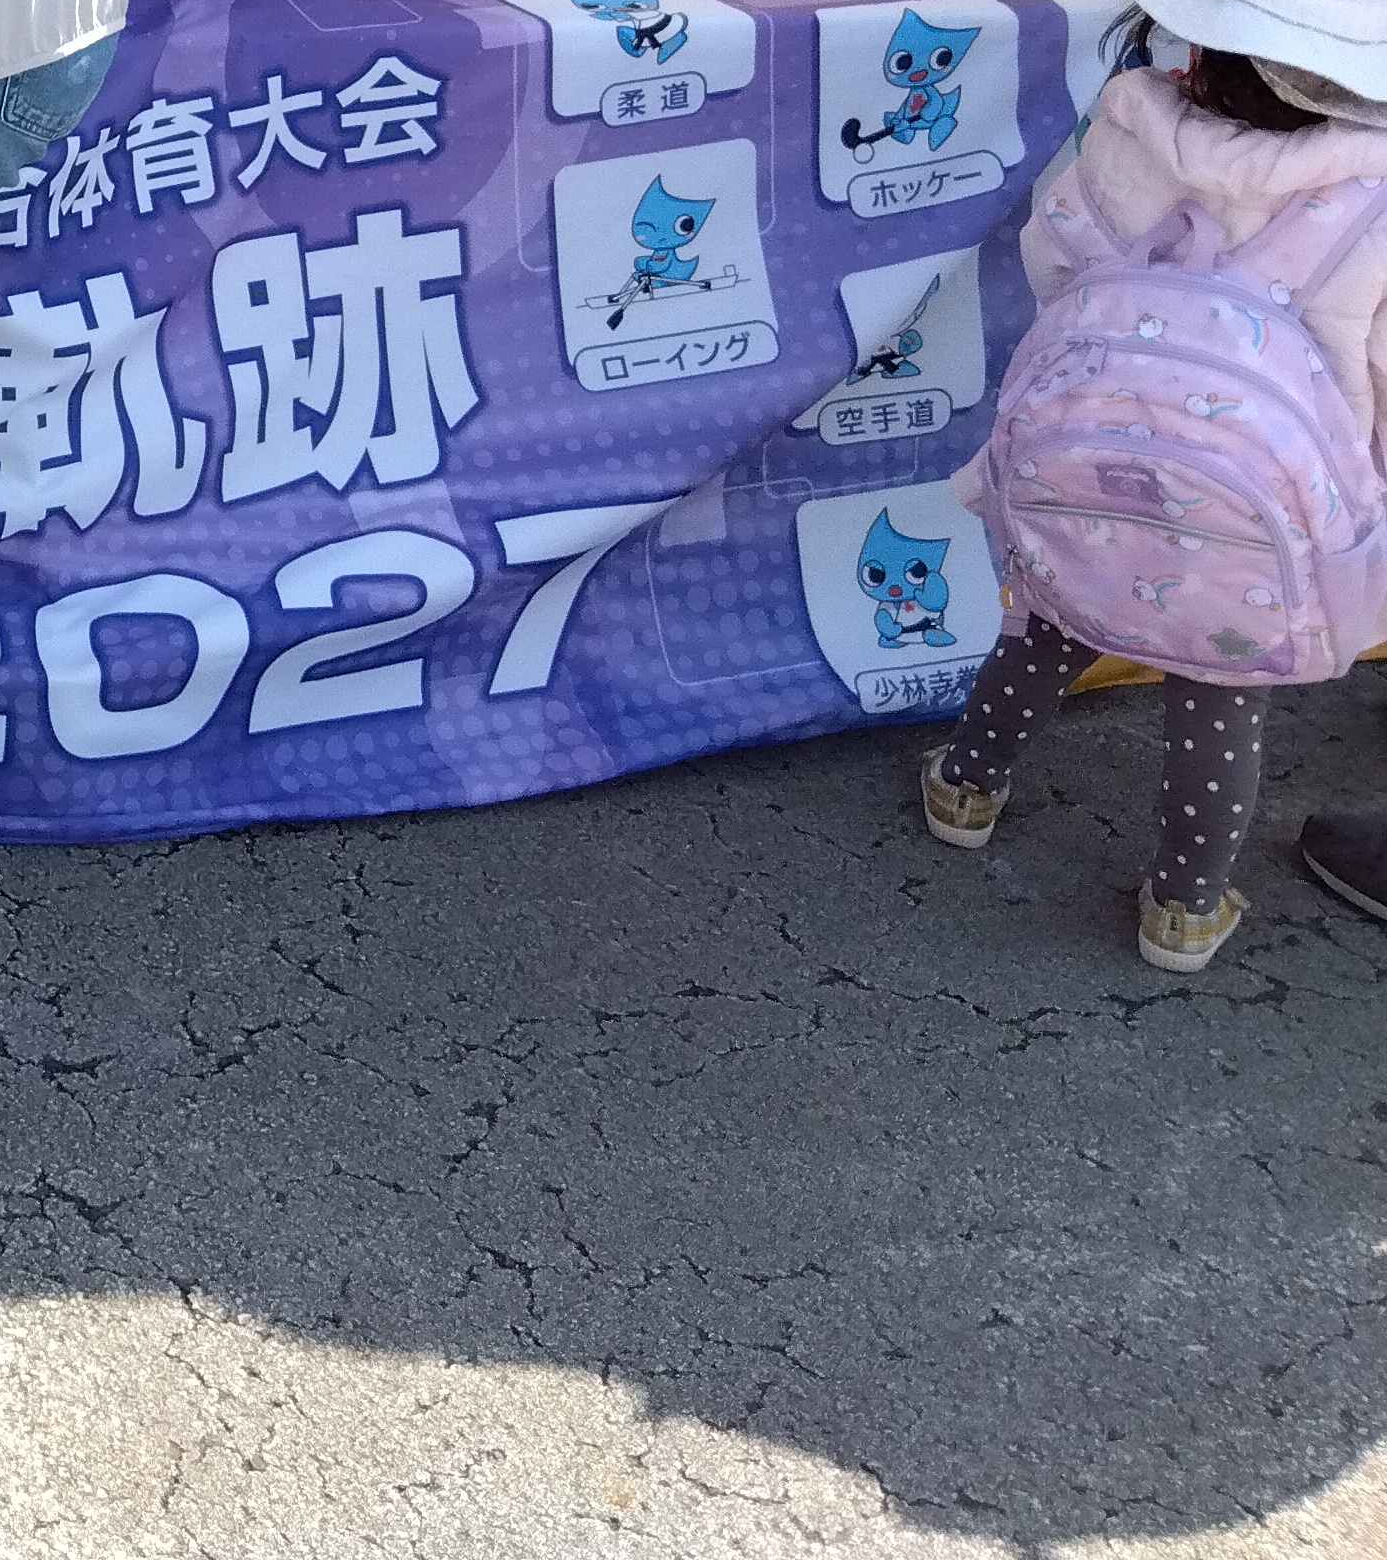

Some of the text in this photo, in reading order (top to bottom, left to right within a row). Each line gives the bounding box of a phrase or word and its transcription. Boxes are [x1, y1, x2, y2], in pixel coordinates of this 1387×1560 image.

[616, 81, 691, 118] 柔道
[869, 167, 984, 209] ホッケー
[601, 332, 751, 382] ローイング
[835, 399, 937, 436] 空手道
